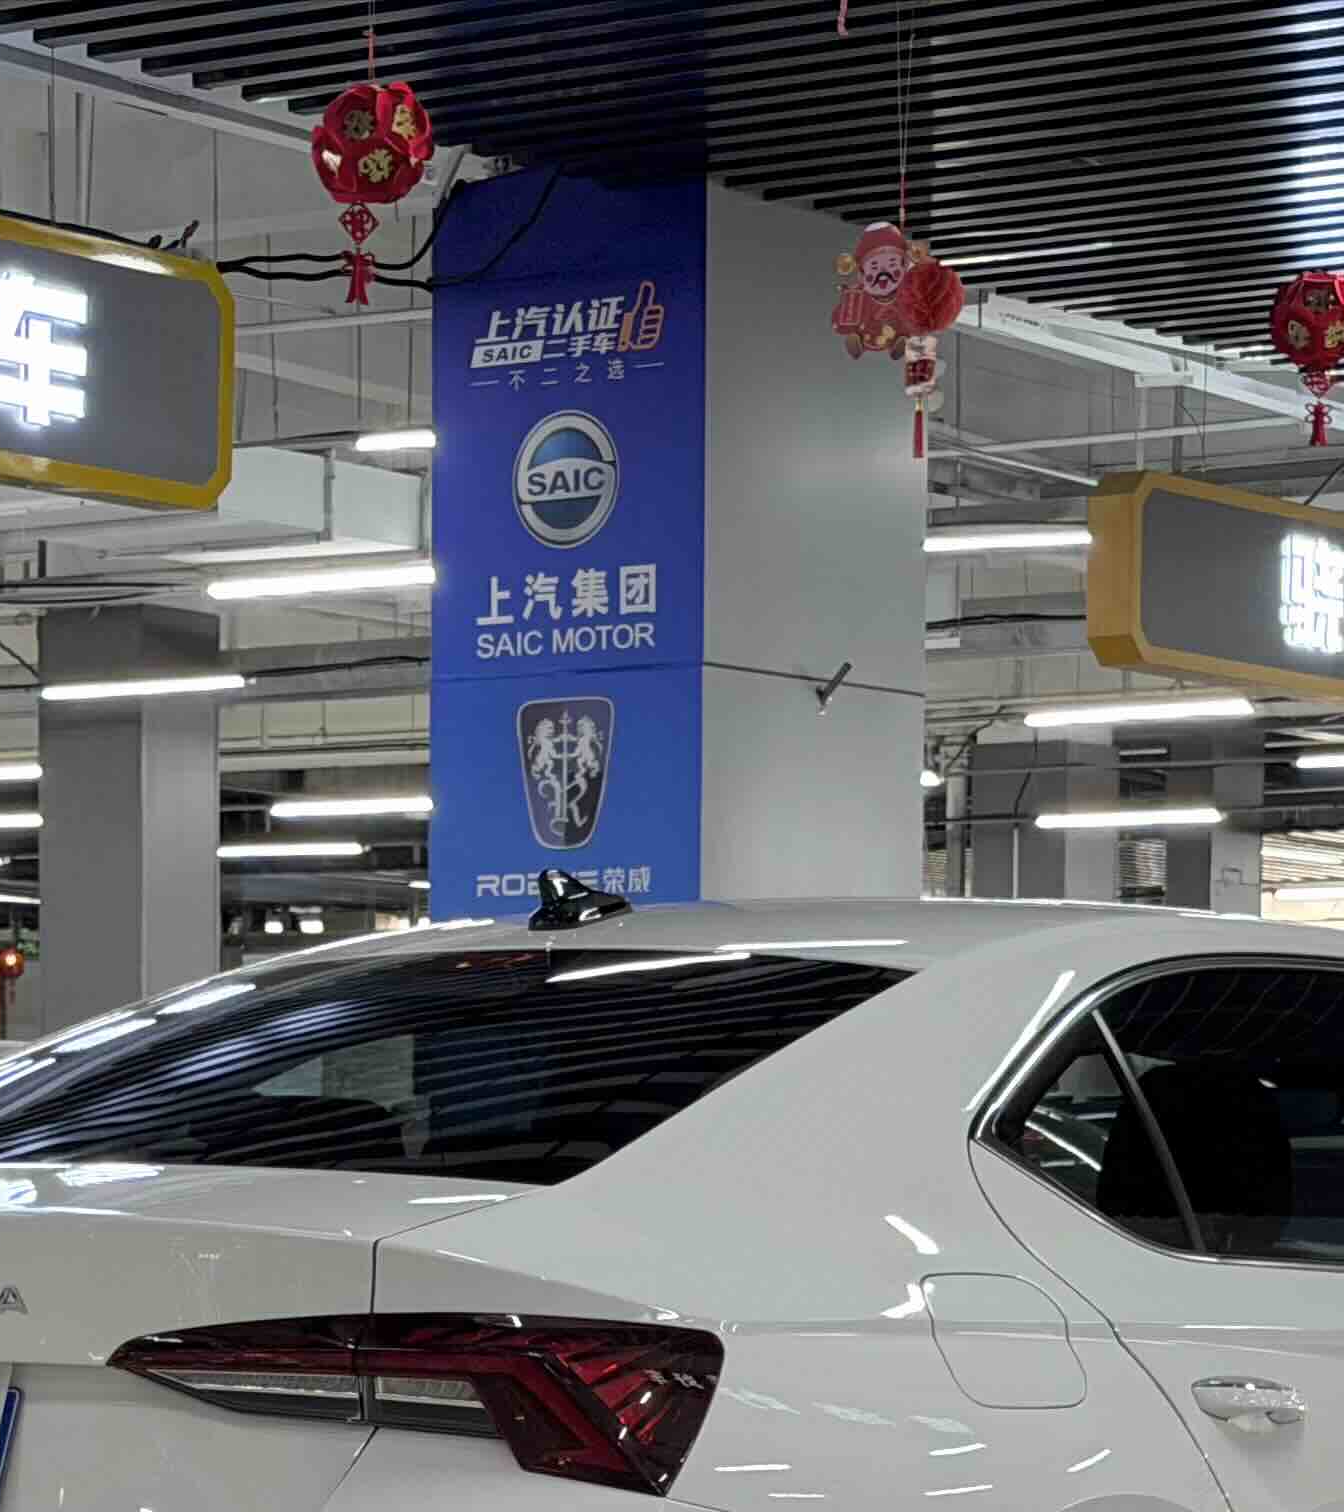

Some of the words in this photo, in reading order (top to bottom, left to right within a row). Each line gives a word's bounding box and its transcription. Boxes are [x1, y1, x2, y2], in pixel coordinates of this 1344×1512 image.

[475, 296, 625, 344] 上汽认证
[482, 345, 533, 363] SAIC
[542, 332, 619, 359] 二手车
[508, 358, 625, 392] 不二之选
[527, 466, 606, 496] SAIC
[476, 563, 657, 626] 上汽集团
[476, 630, 544, 660] SAIC
[551, 623, 656, 654] MOTOR
